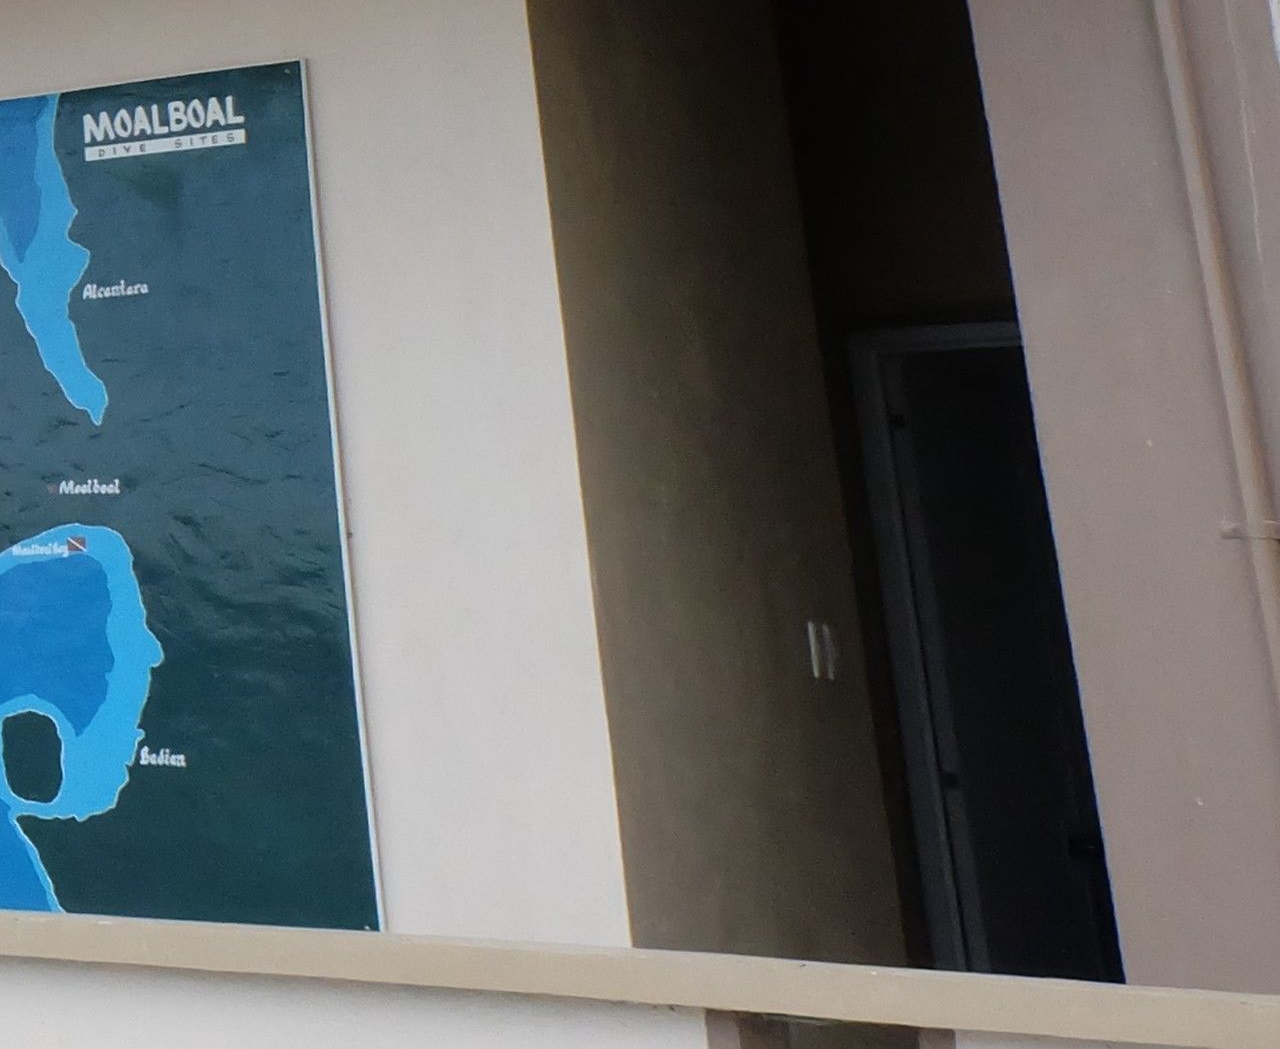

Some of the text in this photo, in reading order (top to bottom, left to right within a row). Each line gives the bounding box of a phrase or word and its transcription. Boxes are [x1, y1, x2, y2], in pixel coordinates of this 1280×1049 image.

[82, 95, 245, 143] MOALBOAL
[98, 132, 235, 158] DIVE SITES
[82, 279, 149, 300] Alcantara
[59, 478, 121, 495] Moalboal
[139, 745, 187, 768] Badian
